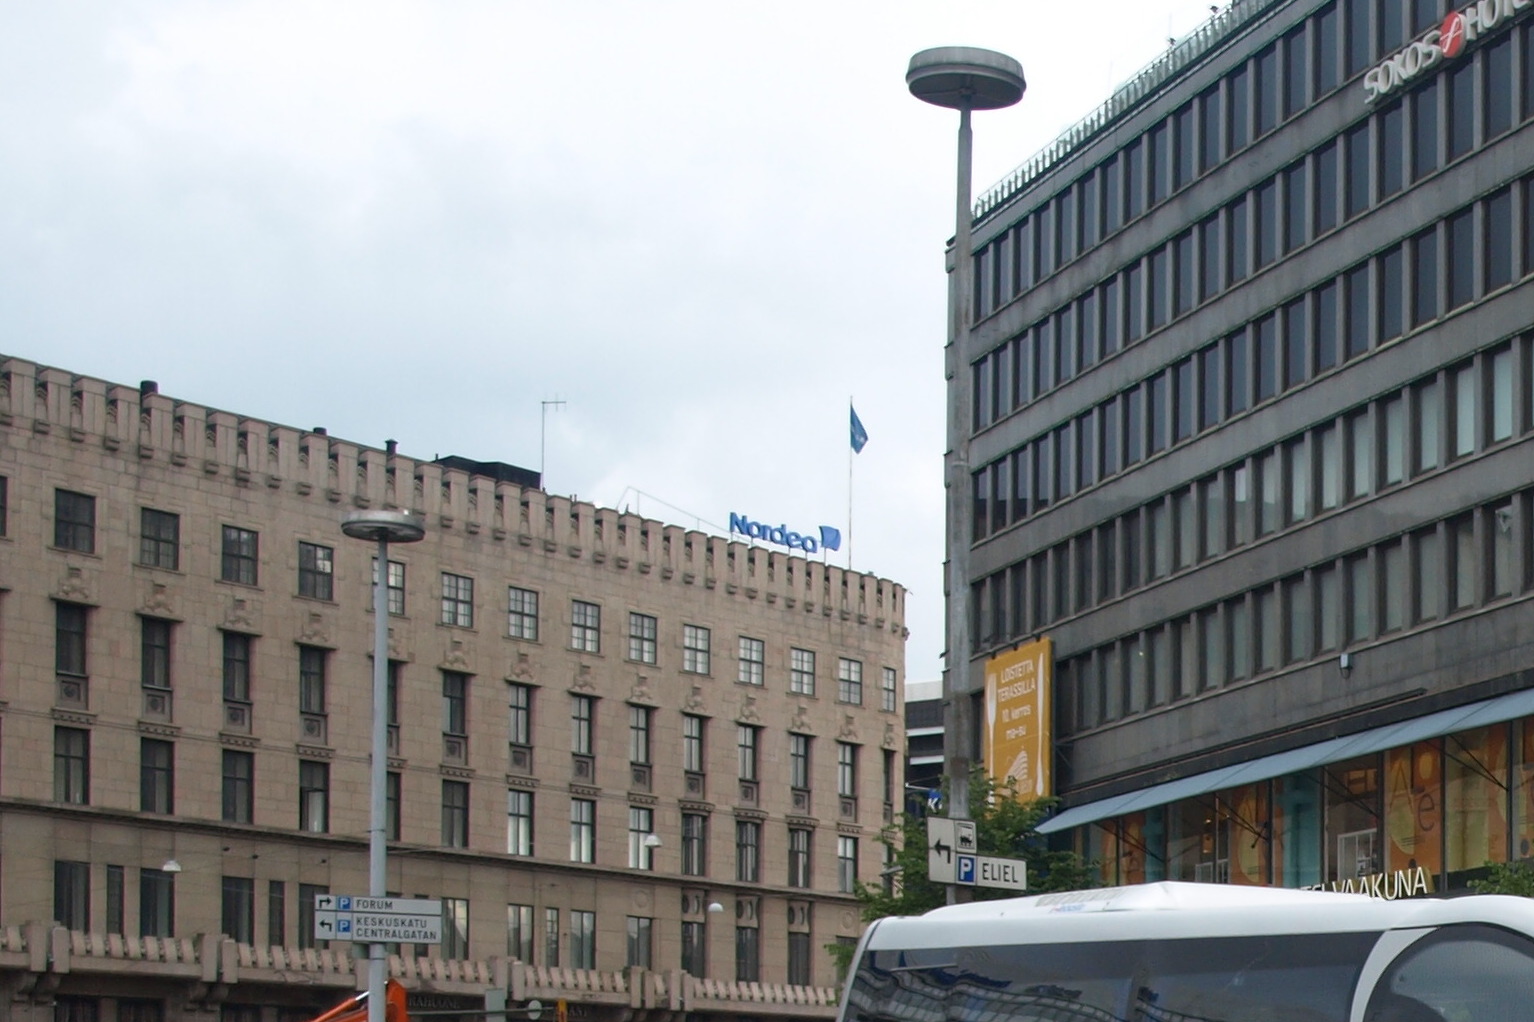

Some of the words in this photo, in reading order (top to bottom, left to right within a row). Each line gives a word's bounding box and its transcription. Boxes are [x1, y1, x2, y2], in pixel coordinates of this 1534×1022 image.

[1364, 30, 1442, 104] SOKOS
[730, 512, 817, 553] Nordea
[1001, 660, 1034, 683] LOISTETTA
[998, 678, 1036, 702] TERASSILLA
[1011, 705, 1031, 721] kerros
[982, 863, 1018, 883] ELIEL
[356, 901, 393, 910] FORUM
[356, 917, 427, 929] KESKUSKATU
[356, 928, 436, 940] CENTRALGATAN
